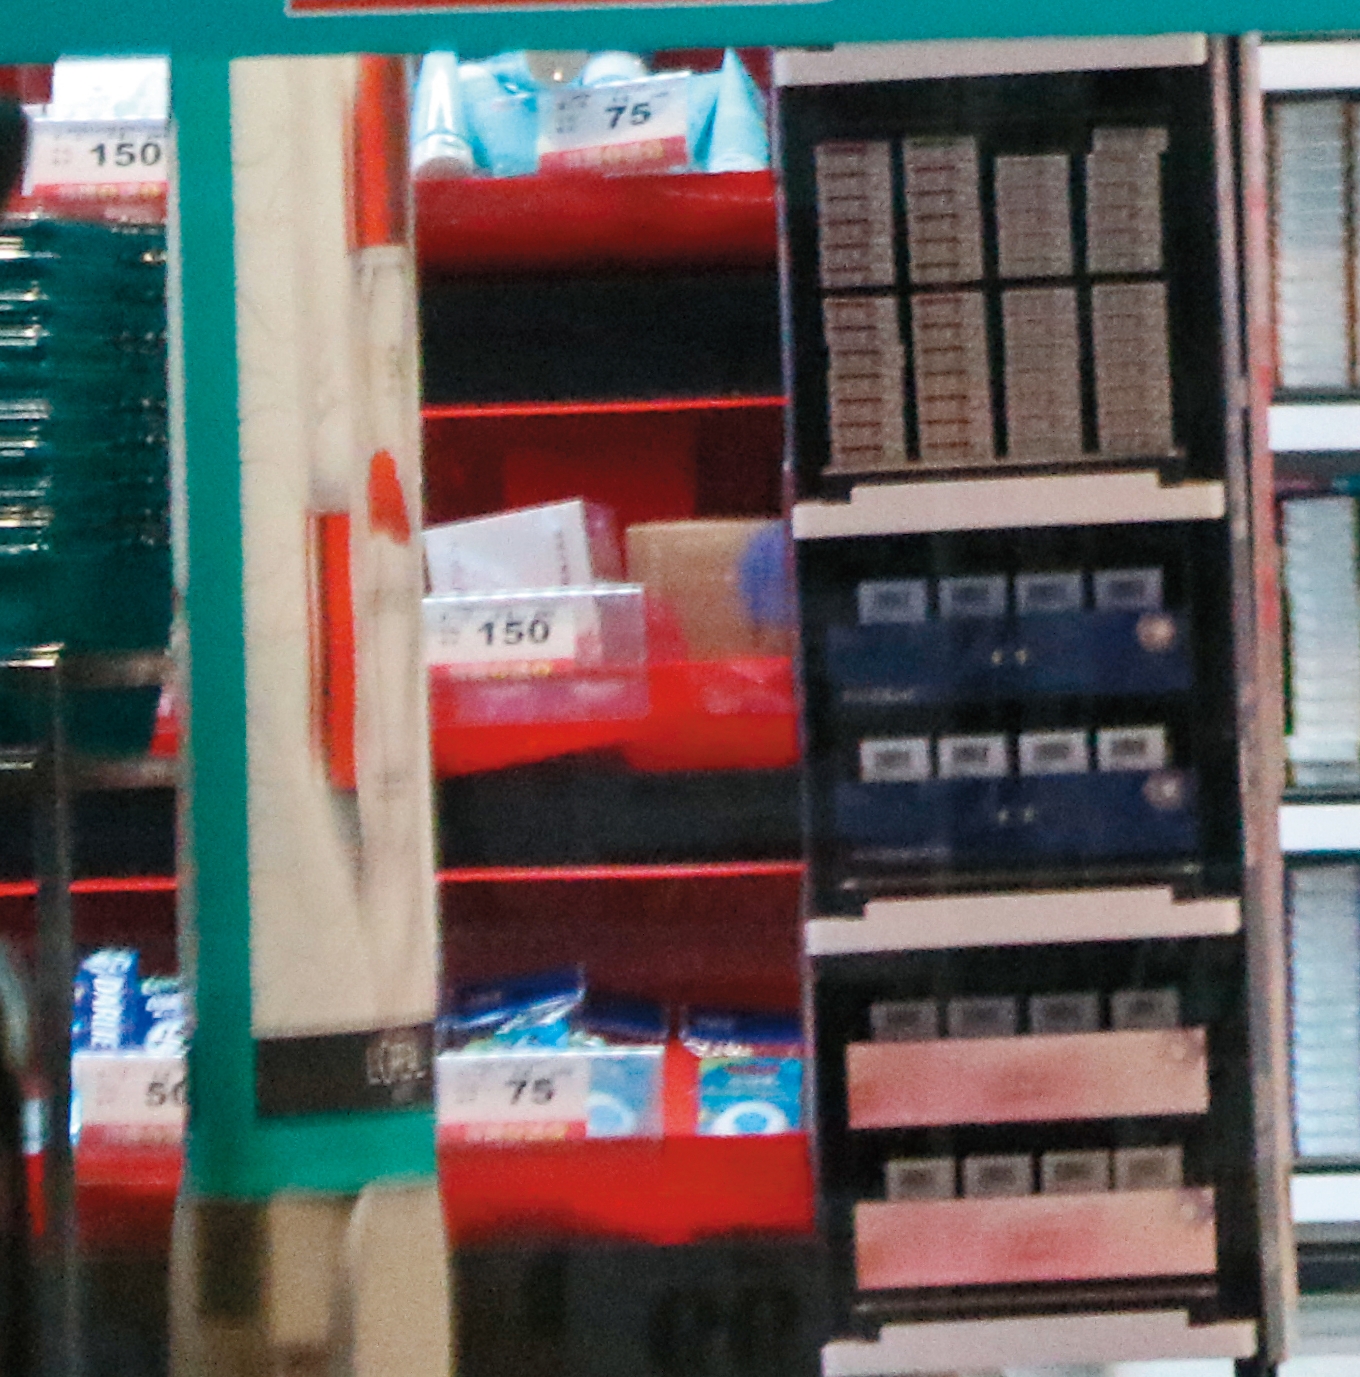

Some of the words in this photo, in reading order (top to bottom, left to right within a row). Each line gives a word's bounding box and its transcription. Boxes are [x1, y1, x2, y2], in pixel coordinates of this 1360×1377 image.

[605, 102, 652, 130] 75
[90, 142, 161, 167] 150
[479, 618, 549, 646] 150
[506, 1078, 556, 1107] 75
